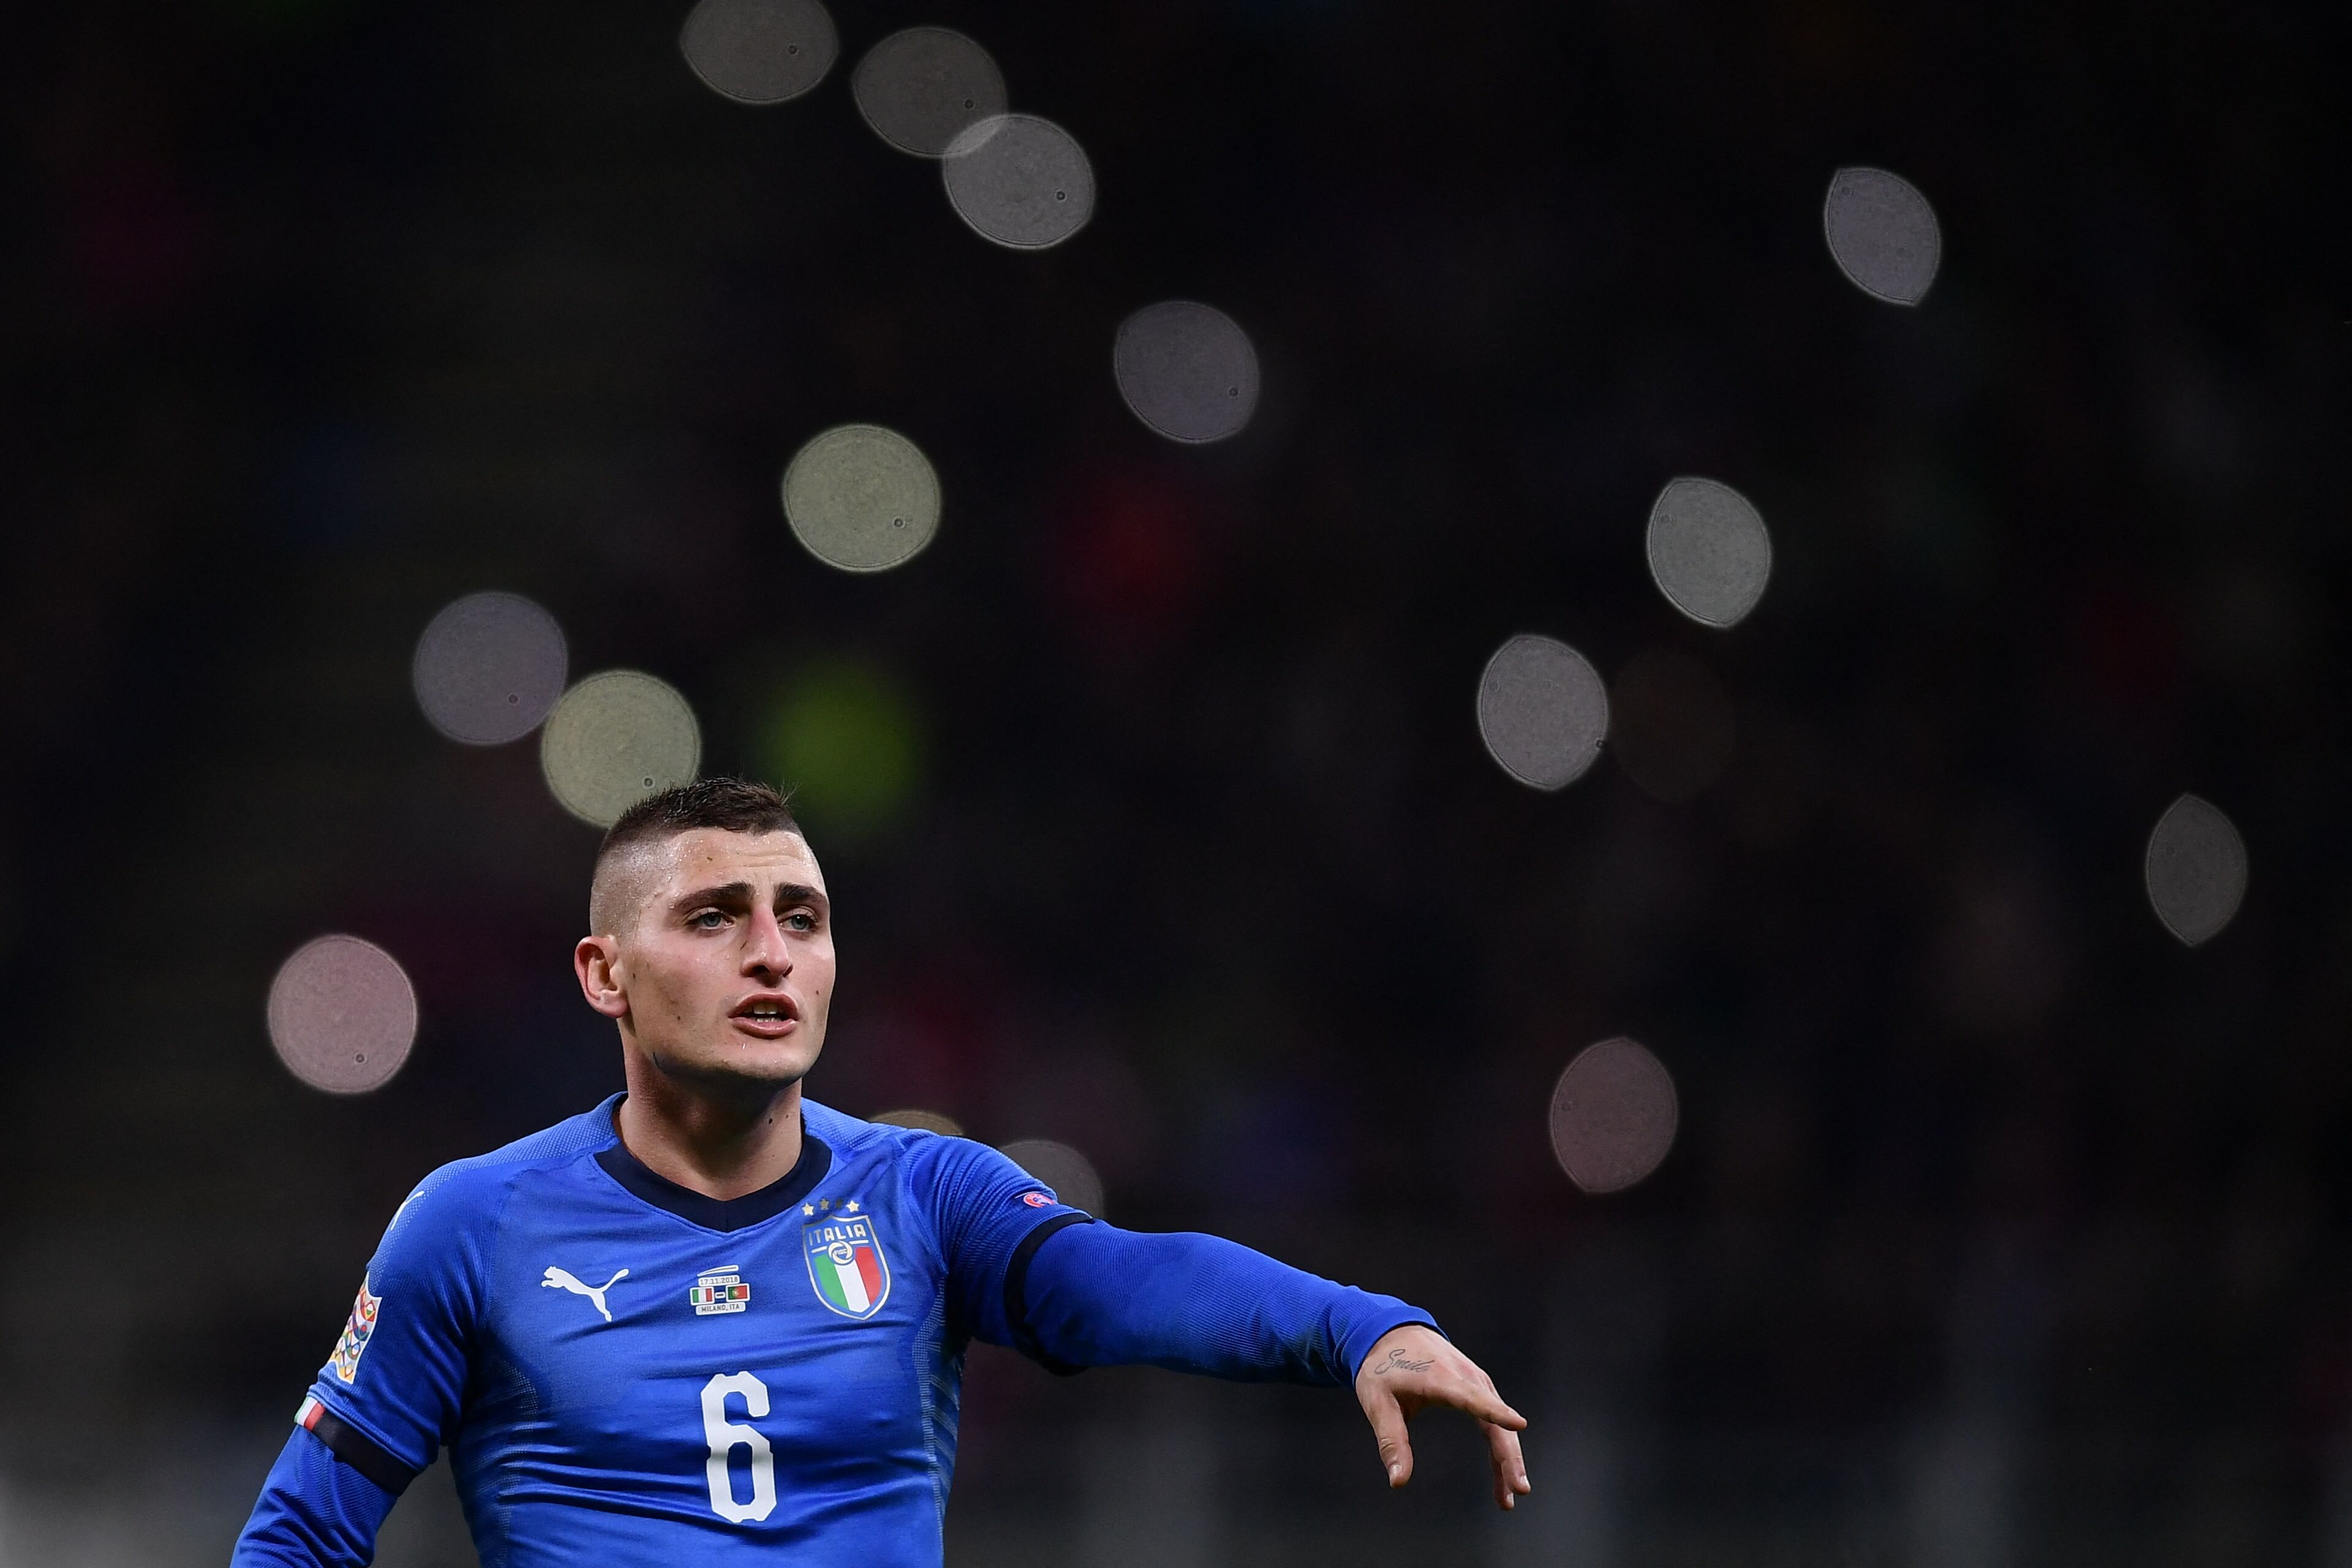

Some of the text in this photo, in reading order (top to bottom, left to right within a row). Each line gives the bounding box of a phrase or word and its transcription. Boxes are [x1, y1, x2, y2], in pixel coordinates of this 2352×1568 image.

[809, 1224, 867, 1246] ITALIA
[700, 1276, 739, 1285] 17.11.2018
[701, 1371, 777, 1523] 6
